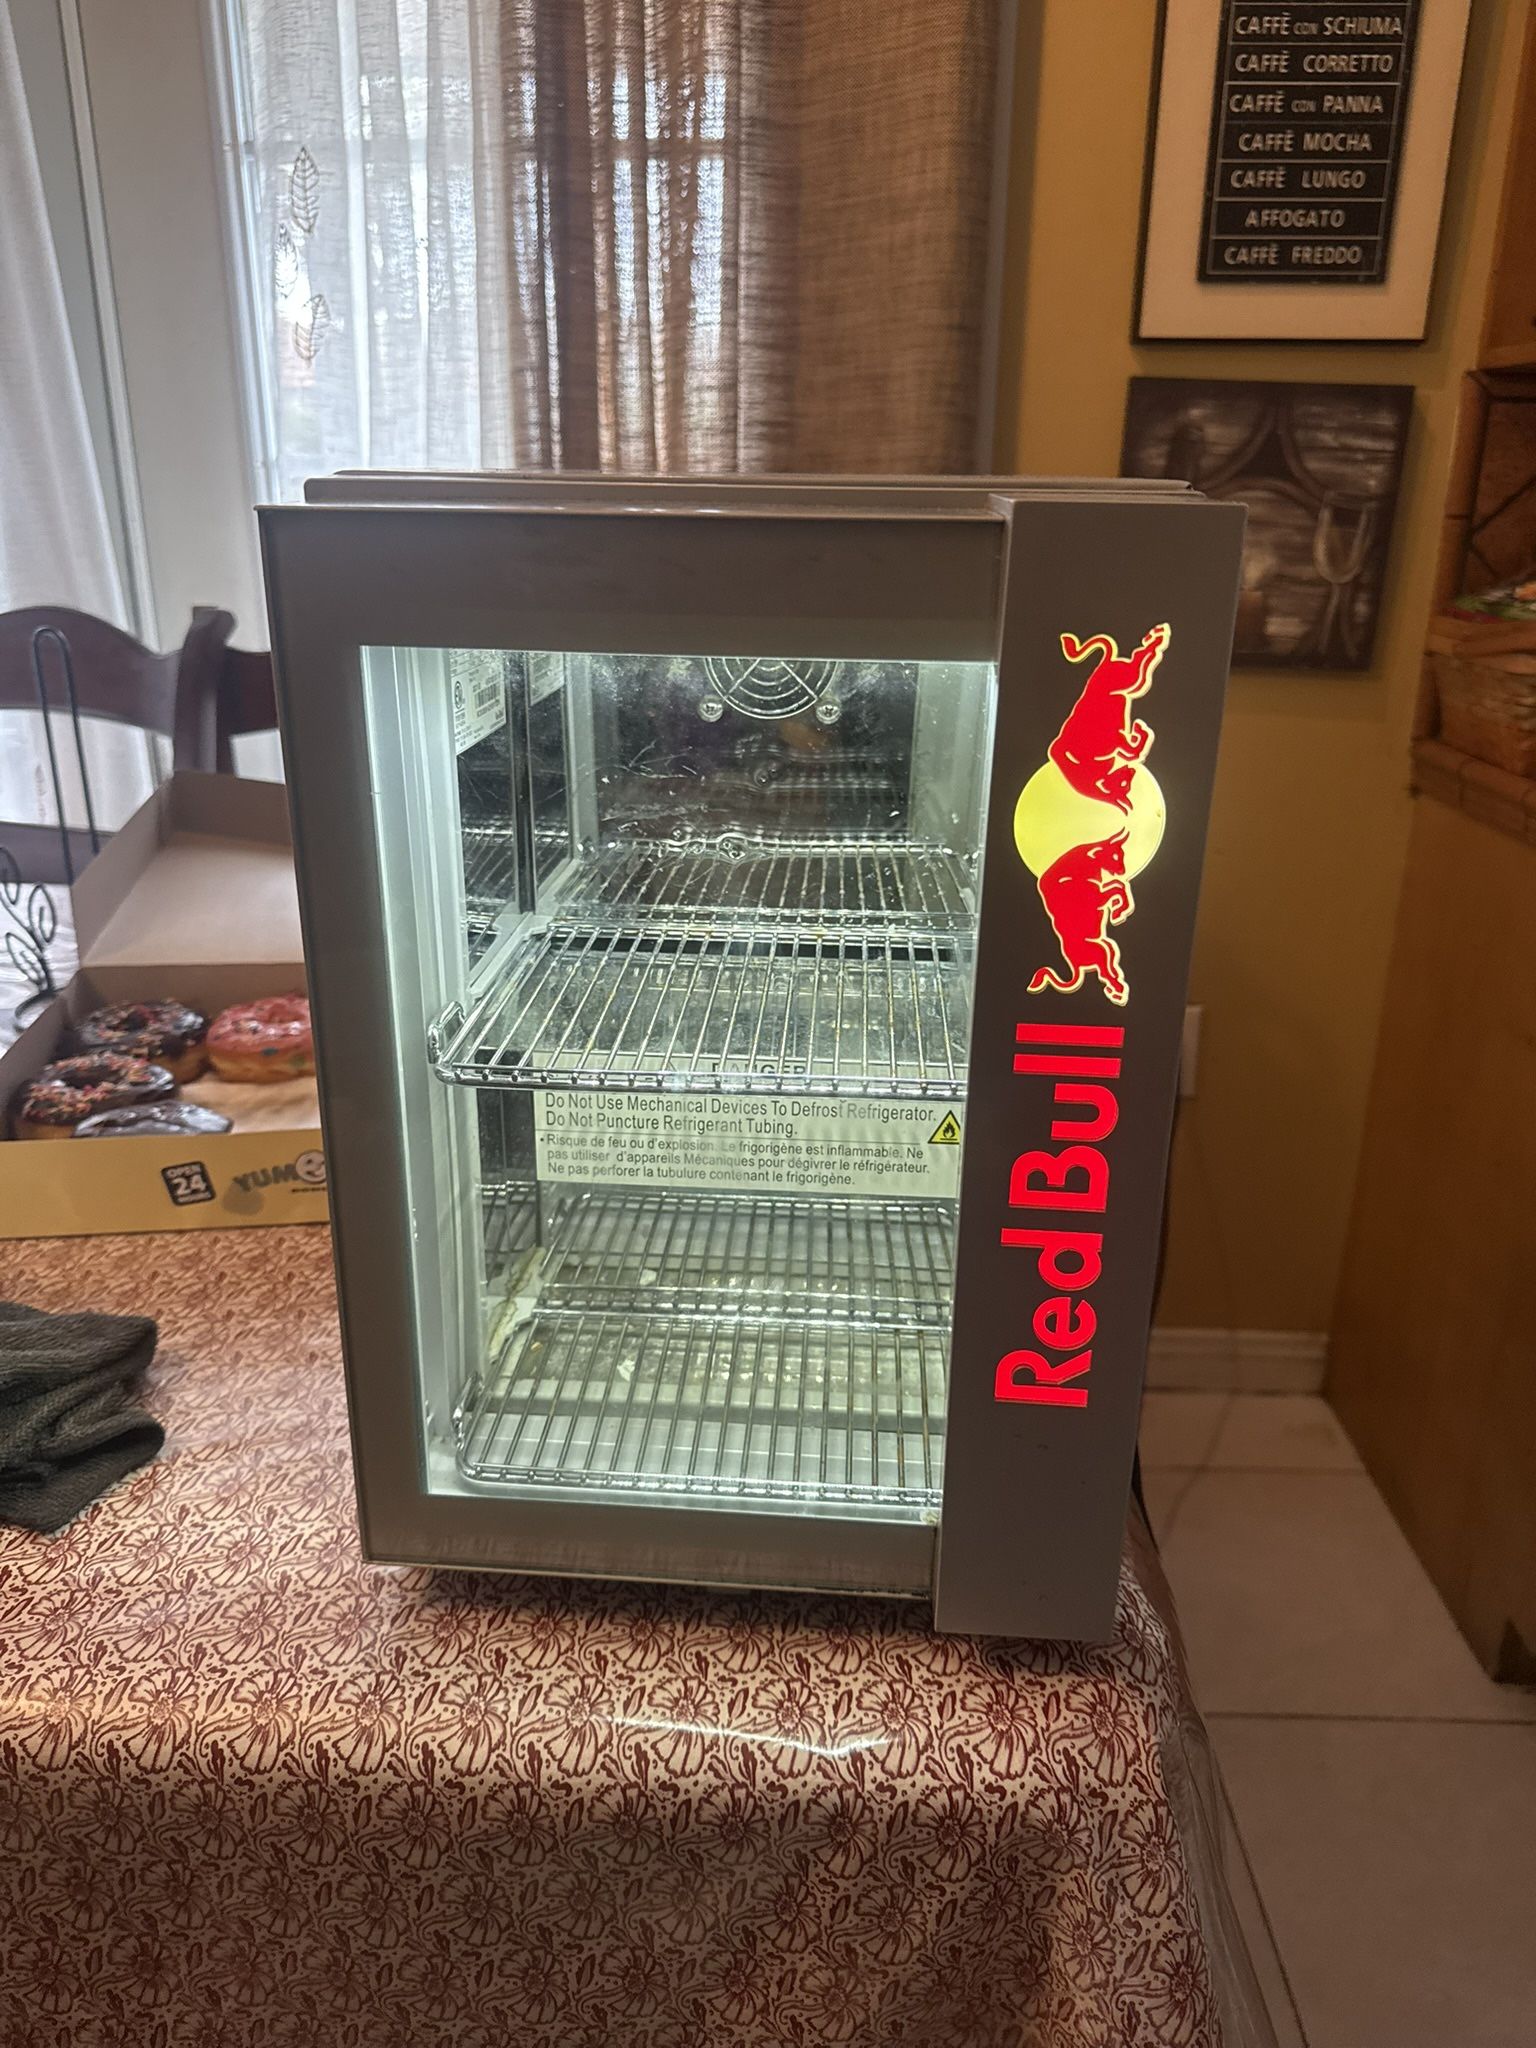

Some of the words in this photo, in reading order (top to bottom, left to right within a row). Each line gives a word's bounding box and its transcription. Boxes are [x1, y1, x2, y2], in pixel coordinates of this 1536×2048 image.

[1322, 16, 1403, 35] SCHIUMA
[1303, 54, 1393, 73] CORRETTO
[1322, 95, 1384, 113] PANNA
[1303, 133, 1372, 151] MOCHA
[1302, 170, 1366, 189] LUNGO
[1245, 210, 1345, 228] AFFOGATO
[1291, 246, 1362, 264] FREDDO
[546, 1093, 564, 1108] Do
[569, 1094, 593, 1109] Not
[596, 1095, 623, 1110] Use
[627, 1096, 707, 1113] Mechanical
[712, 1099, 767, 1115] Devices
[771, 1101, 787, 1116] To
[791, 1102, 844, 1118] Defrost
[847, 1103, 936, 1123] Refrigerator.
[546, 1111, 565, 1126] Do
[569, 1112, 593, 1127] Not
[597, 1113, 659, 1129] Puncture
[664, 1116, 742, 1134] Refrigerant
[746, 1118, 798, 1138] Tubing.
[547, 1134, 587, 1148] Risque
[591, 1136, 604, 1147] de
[608, 1136, 626, 1148] feu
[630, 1139, 644, 1149] ou
[722, 1142, 736, 1152] Le
[739, 1142, 802, 1156] frigorigène
[806, 1145, 824, 1155] est
[827, 1144, 903, 1158] inflammable.
[907, 1148, 923, 1158] Ne
[547, 1151, 568, 1161] pas
[572, 1150, 609, 1161] utiliser
[616, 1151, 680, 1165] d'appareils
[684, 1153, 755, 1167] Mécaniques
[758, 1159, 784, 1169] pour
[788, 1157, 836, 1171] dégivrer
[840, 1159, 850, 1171] le
[548, 1163, 564, 1174] Ne
[568, 1165, 589, 1176] pas
[593, 1165, 639, 1177] perforer
[643, 1165, 653, 1177] la
[657, 1166, 706, 1180] tubulure
[709, 1169, 769, 1181] contenant
[772, 1170, 783, 1181] le
[786, 1170, 855, 1186] frigorigène.
[172, 1174, 206, 1196] 24
